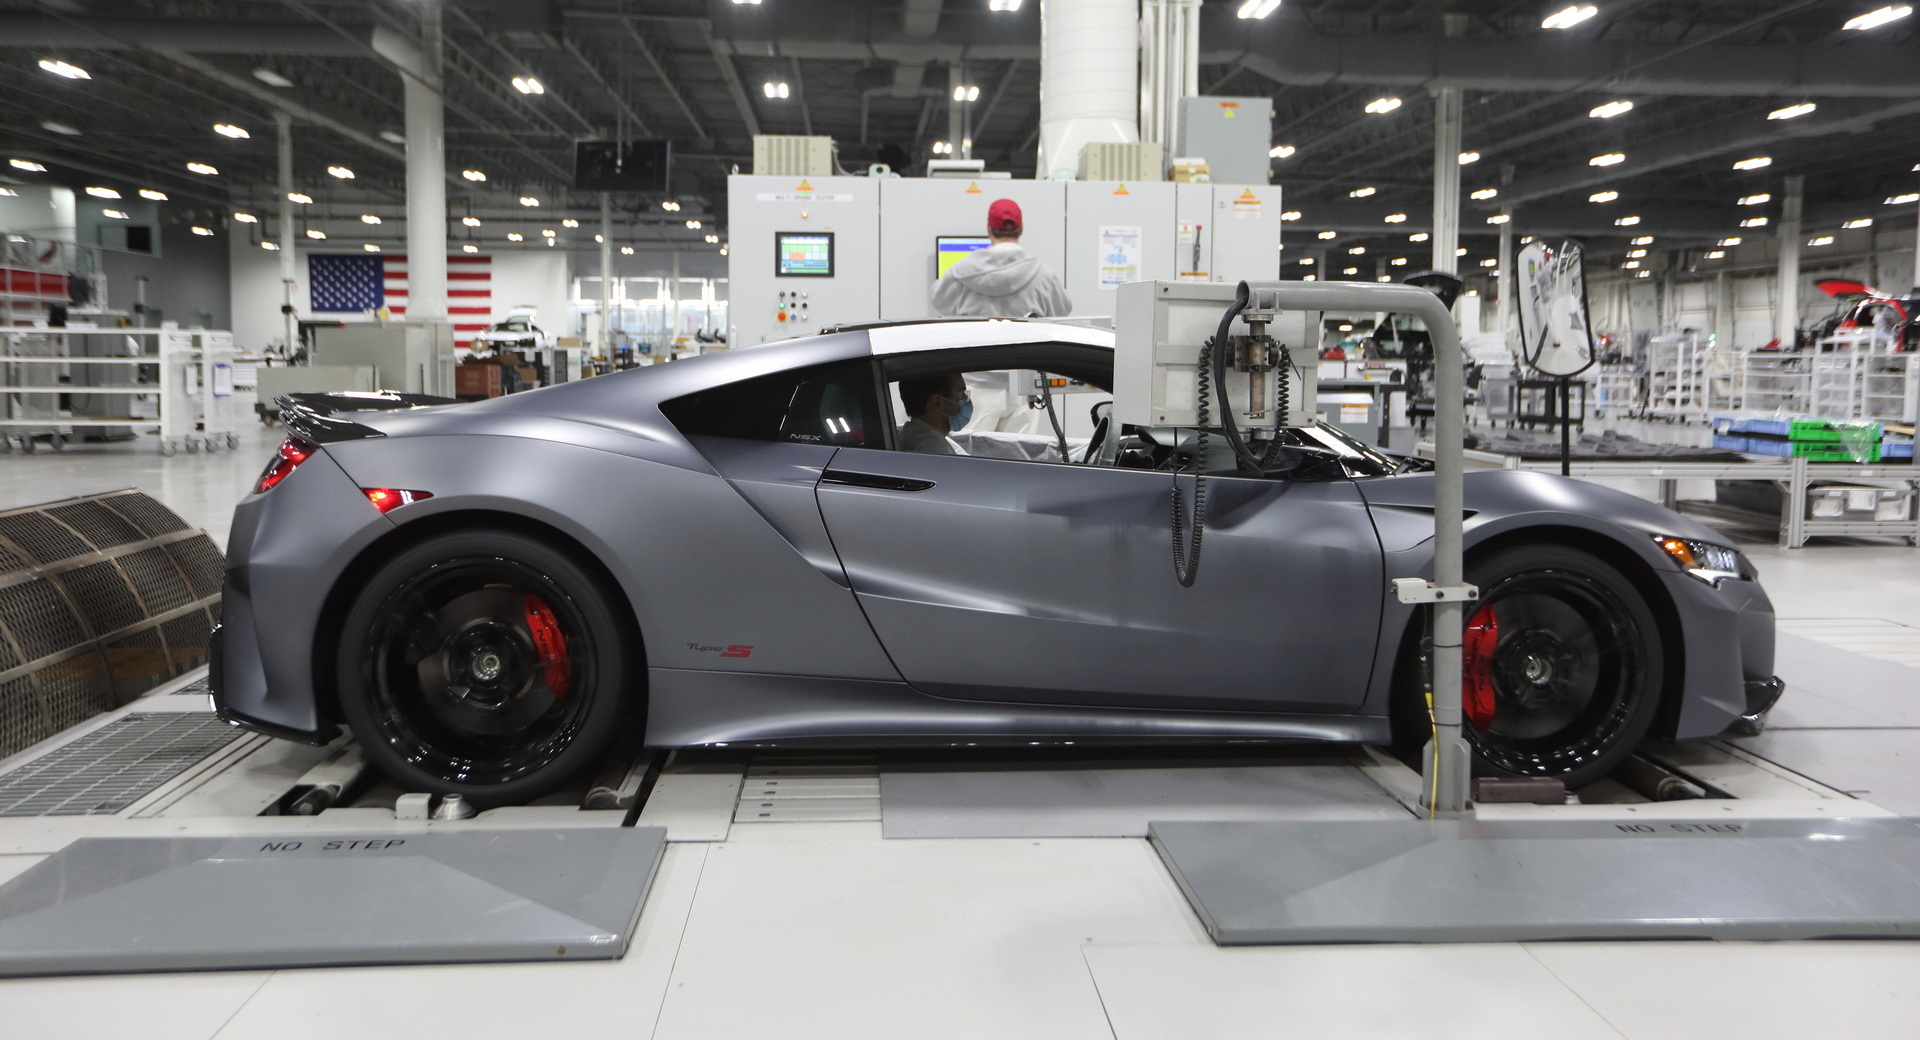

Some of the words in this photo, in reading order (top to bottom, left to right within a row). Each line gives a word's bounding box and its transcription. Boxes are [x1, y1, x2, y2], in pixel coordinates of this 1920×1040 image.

[790, 433, 822, 441] NSX
[686, 642, 724, 652] Type
[720, 645, 754, 658] S
[1615, 823, 1656, 833] NO
[1669, 823, 1743, 833] STEP
[259, 841, 303, 852] NO
[322, 839, 406, 850] STEP
